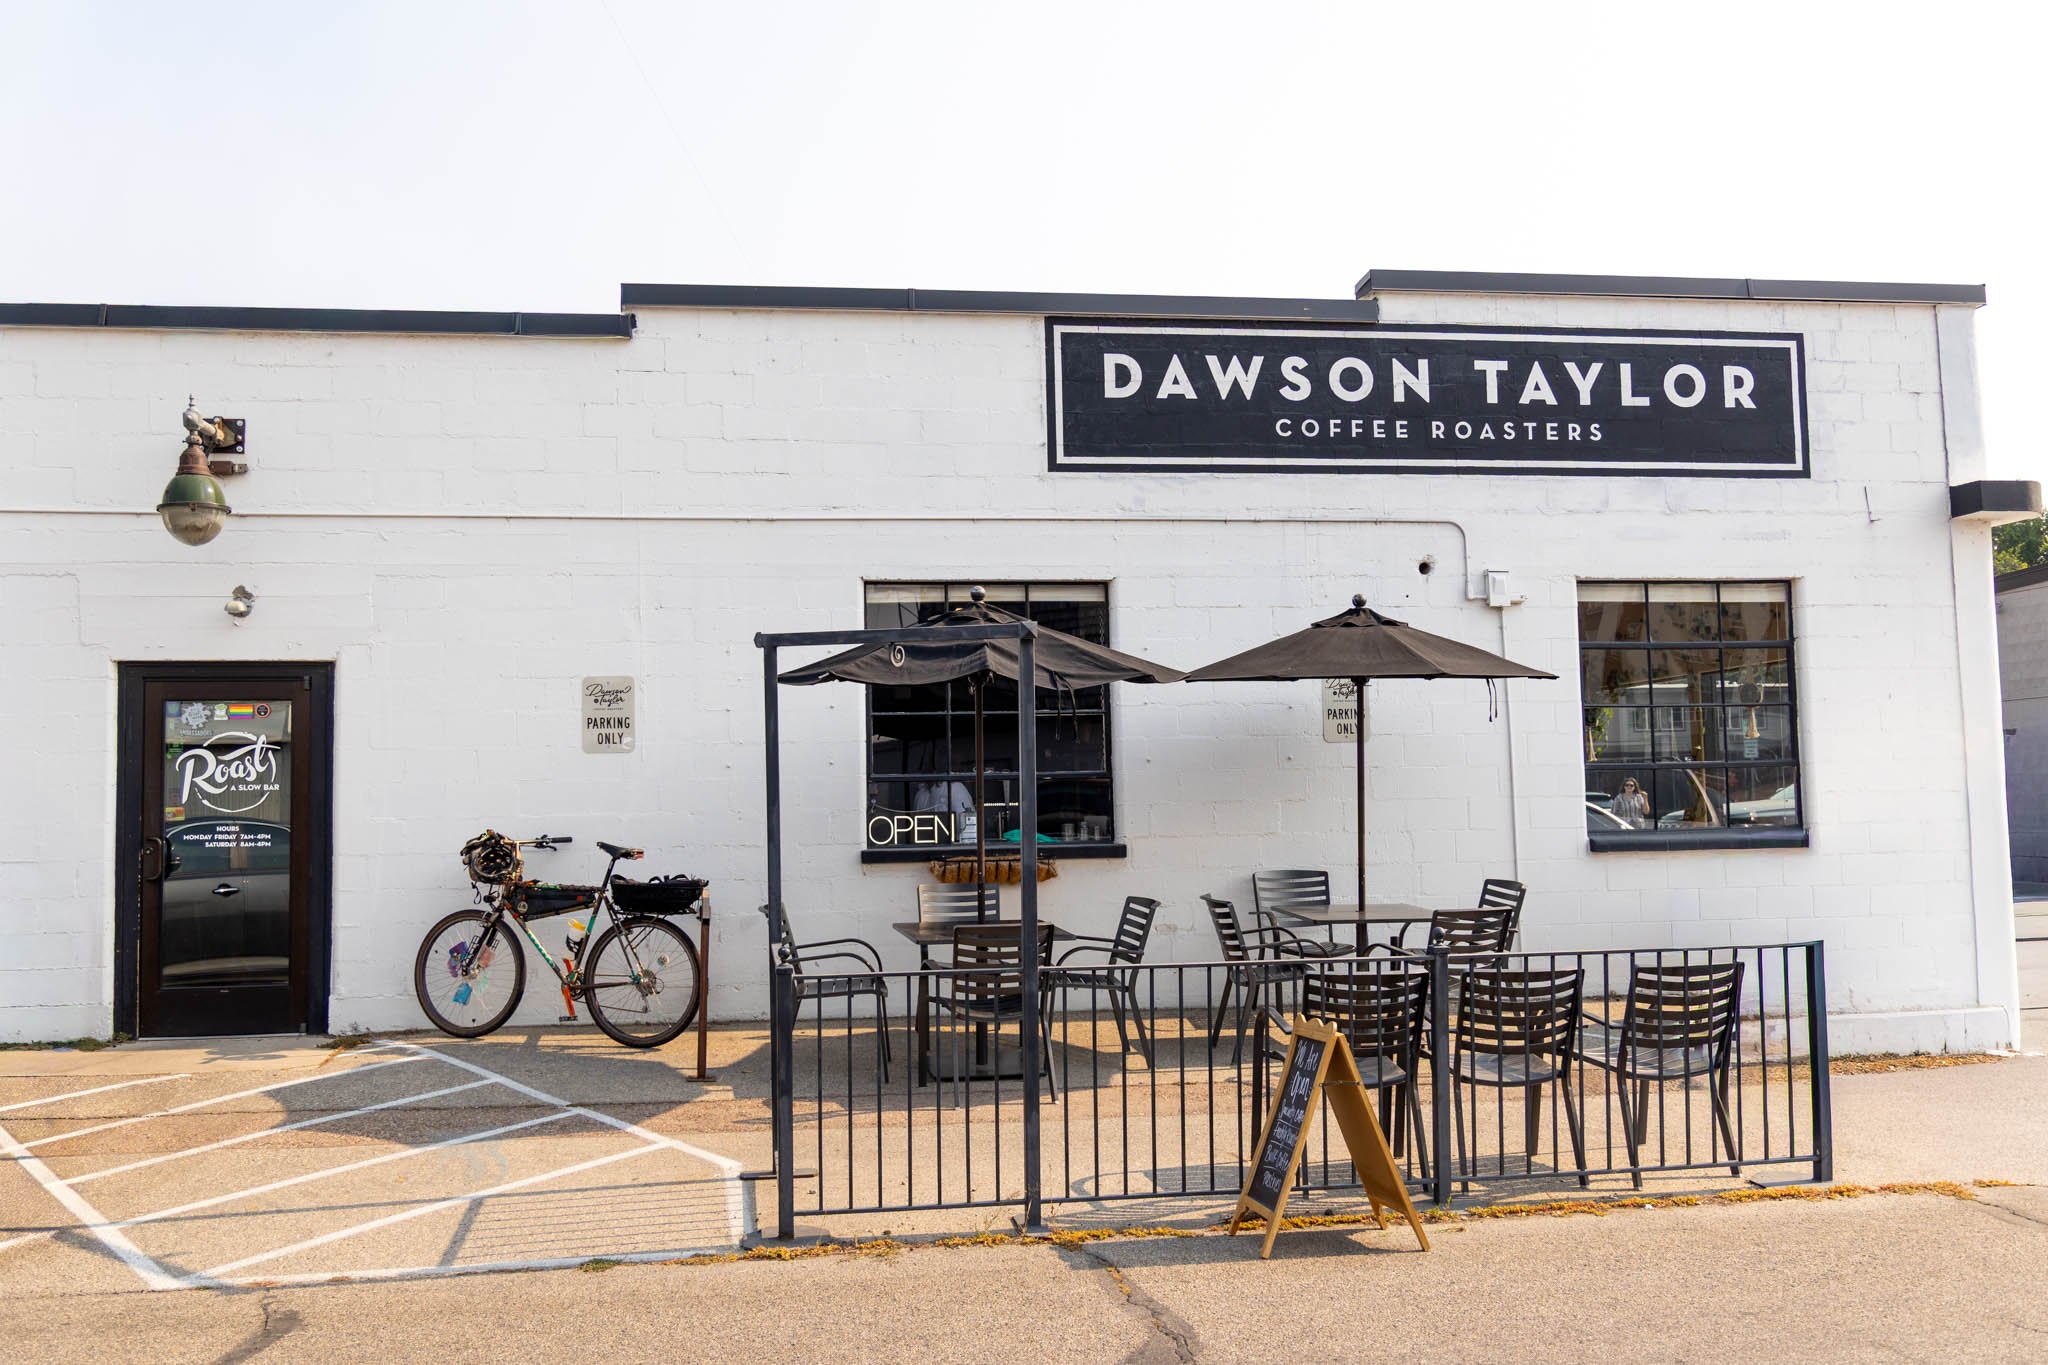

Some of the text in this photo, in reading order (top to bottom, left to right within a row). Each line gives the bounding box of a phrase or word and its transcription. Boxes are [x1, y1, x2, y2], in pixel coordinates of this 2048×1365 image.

[1103, 353, 1757, 409] DAWSON TAYLOR
[1275, 418, 1602, 441] COFFEE ROASTERS
[587, 717, 630, 729] PARKING
[1328, 708, 1358, 720] PARKIN
[597, 732, 624, 744] ONLY
[176, 734, 280, 804] Roast
[868, 813, 955, 845] OPEN
